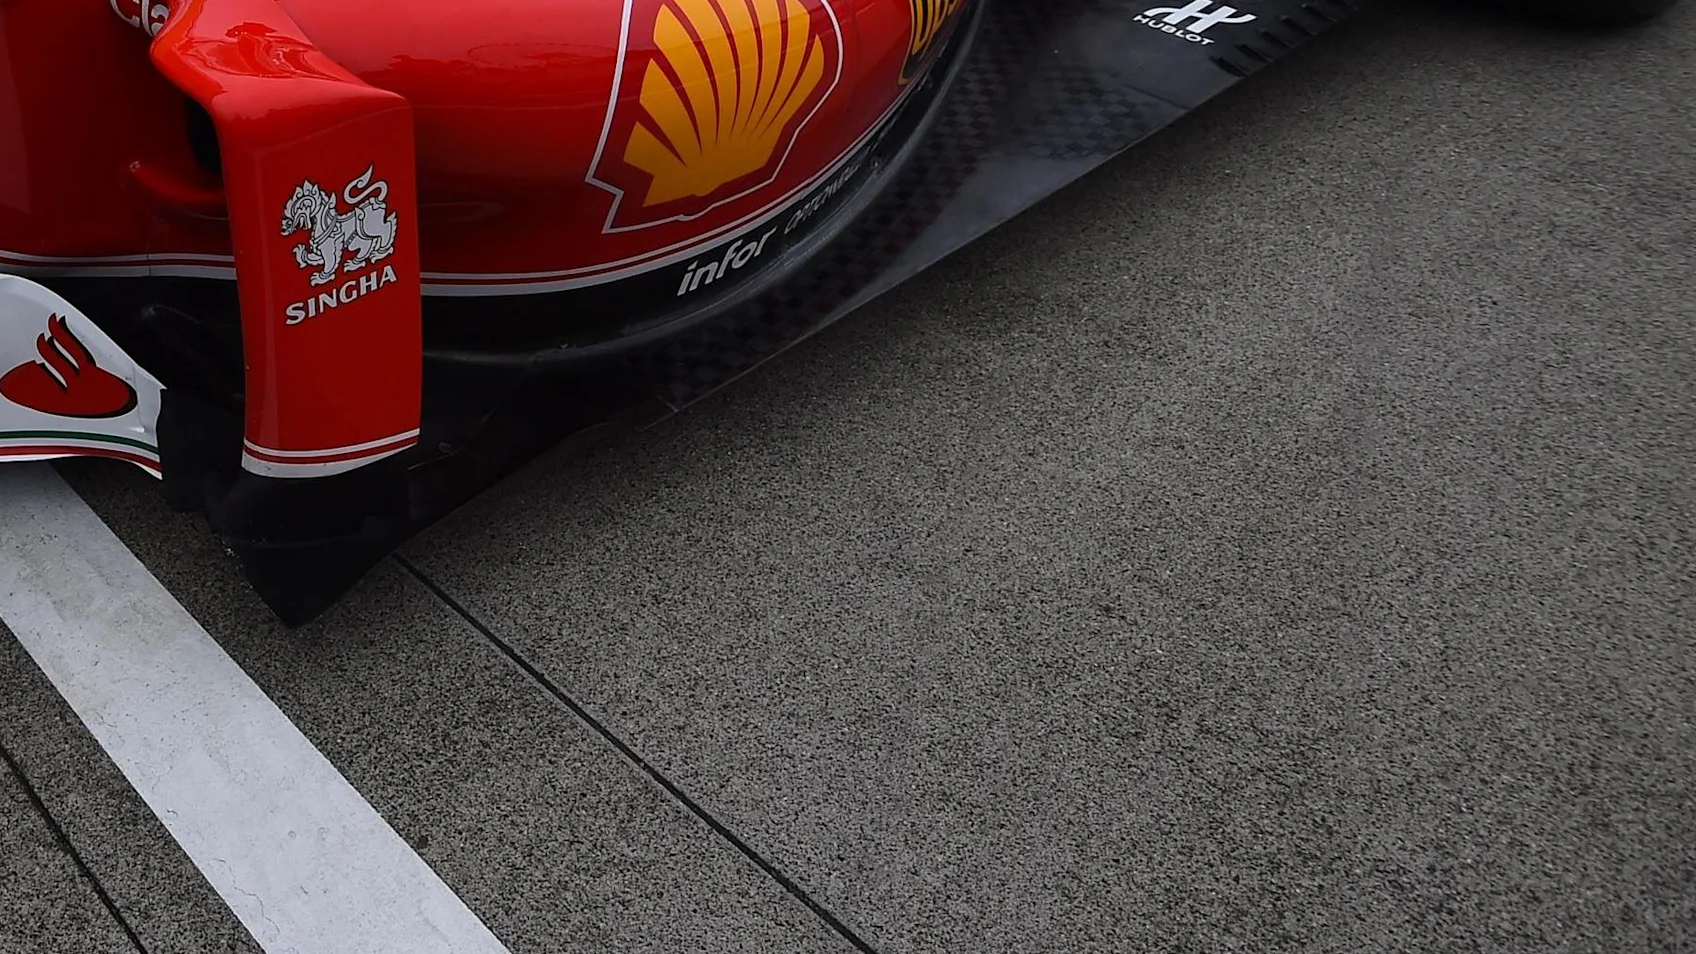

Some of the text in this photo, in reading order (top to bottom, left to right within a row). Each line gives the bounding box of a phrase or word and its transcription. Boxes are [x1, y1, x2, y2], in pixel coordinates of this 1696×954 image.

[1133, 13, 1215, 46] HUBLOT
[677, 225, 779, 297] infor
[285, 265, 398, 326] SINGHA
